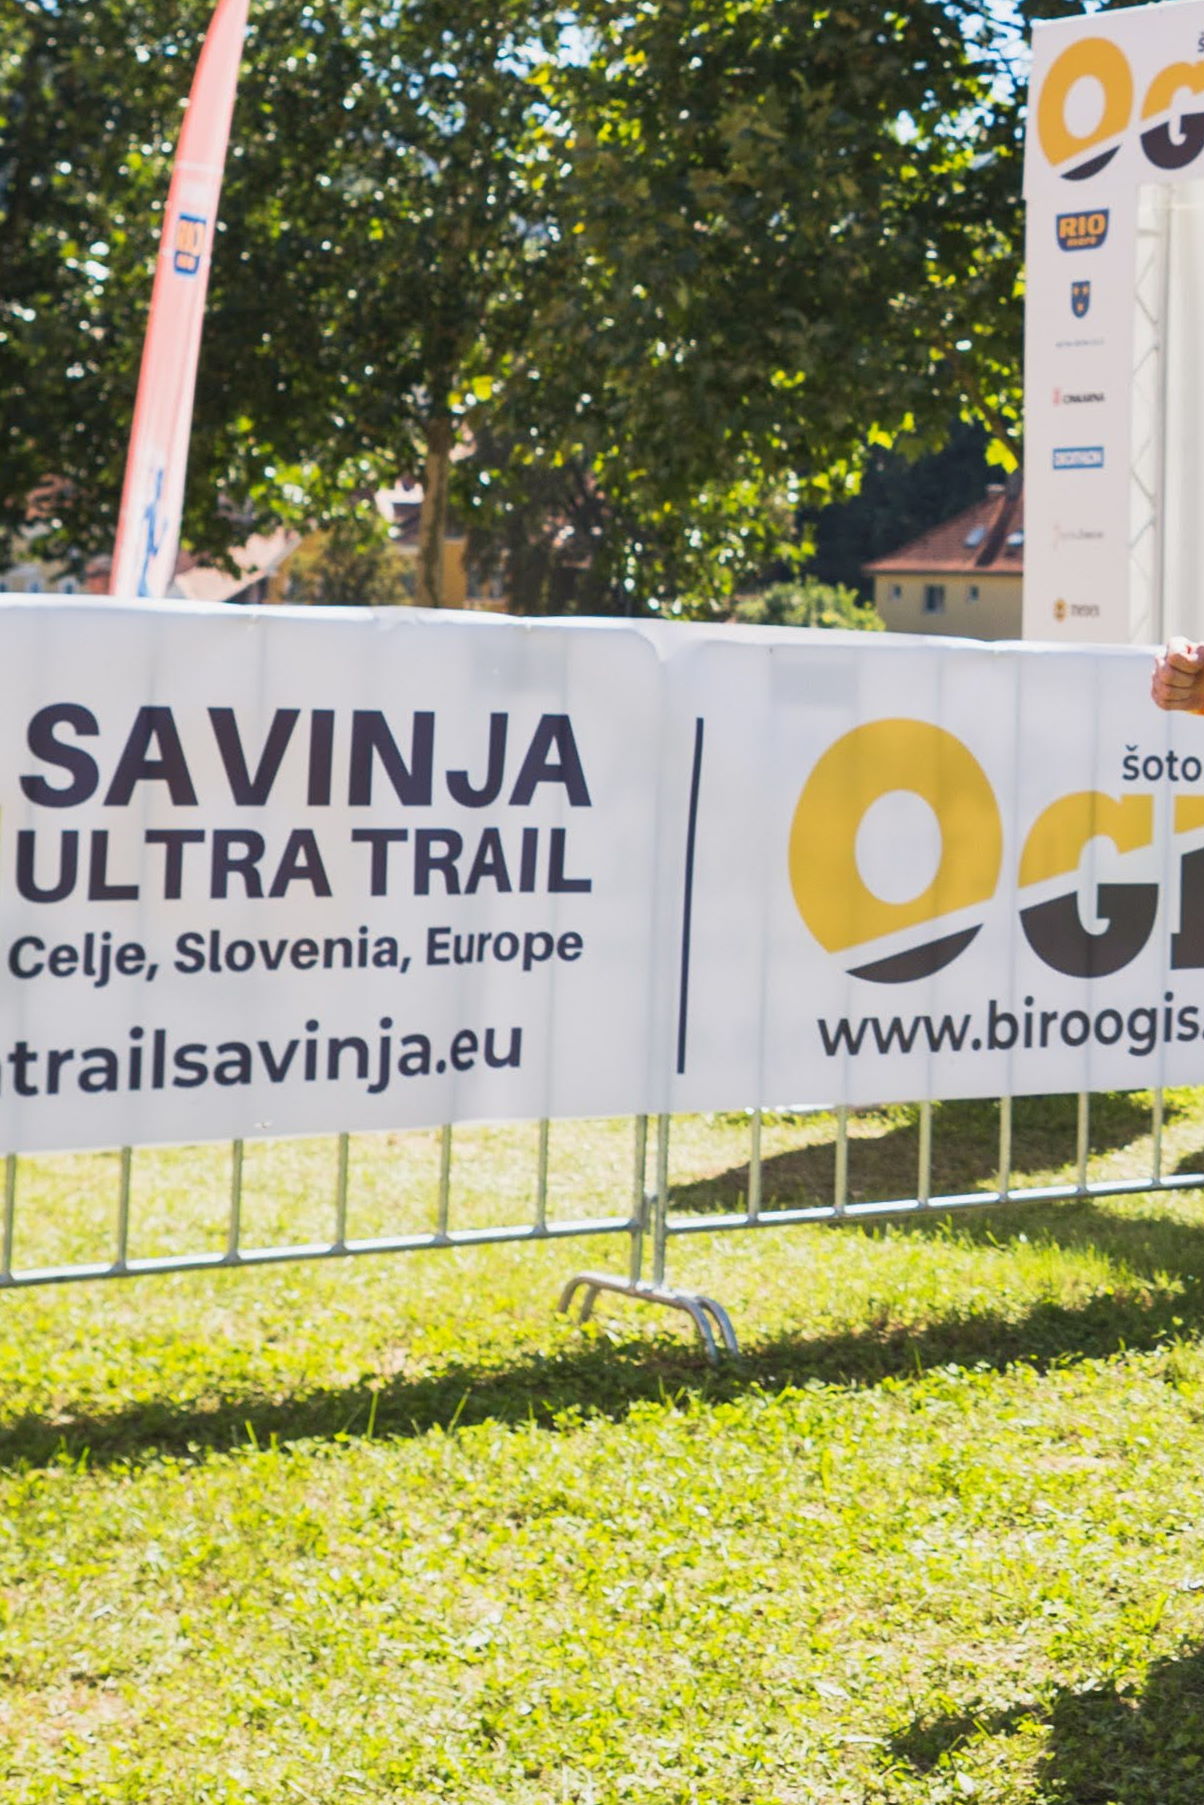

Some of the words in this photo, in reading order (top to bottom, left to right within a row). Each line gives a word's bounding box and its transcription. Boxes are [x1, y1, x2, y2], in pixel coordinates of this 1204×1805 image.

[1058, 213, 1106, 239] RIO
[19, 702, 593, 809] SAVINJA
[15, 828, 332, 904] ULTRA
[351, 827, 592, 897] TRAIL
[8, 931, 158, 989] Celje,
[174, 925, 411, 975] Slovenia,
[425, 927, 584, 972] Europe
[0, 1017, 523, 1098] trailsavinja.eu
